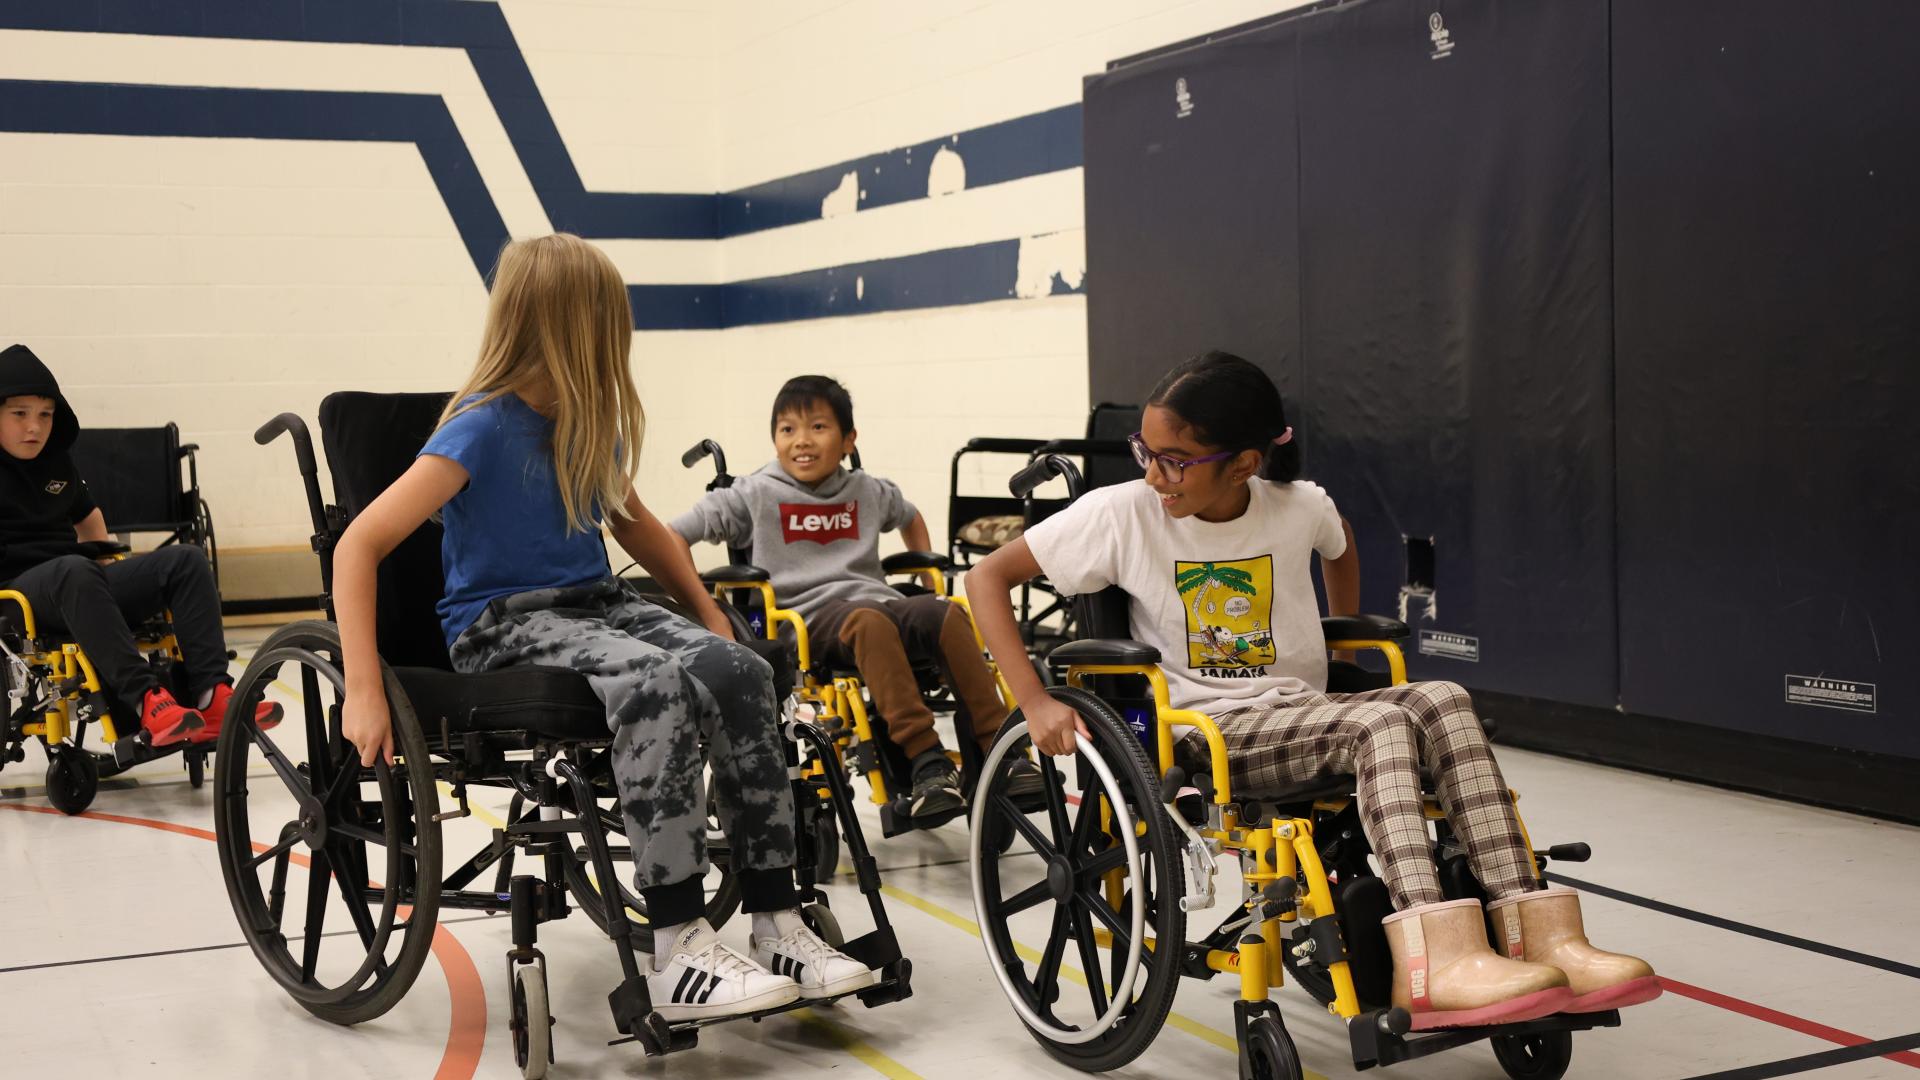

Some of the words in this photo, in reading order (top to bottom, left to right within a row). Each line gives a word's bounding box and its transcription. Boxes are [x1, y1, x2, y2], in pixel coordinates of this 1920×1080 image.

[1804, 679, 1856, 692] WARNING
[682, 927, 700, 946] adidas
[1411, 968, 1426, 999] UGG
